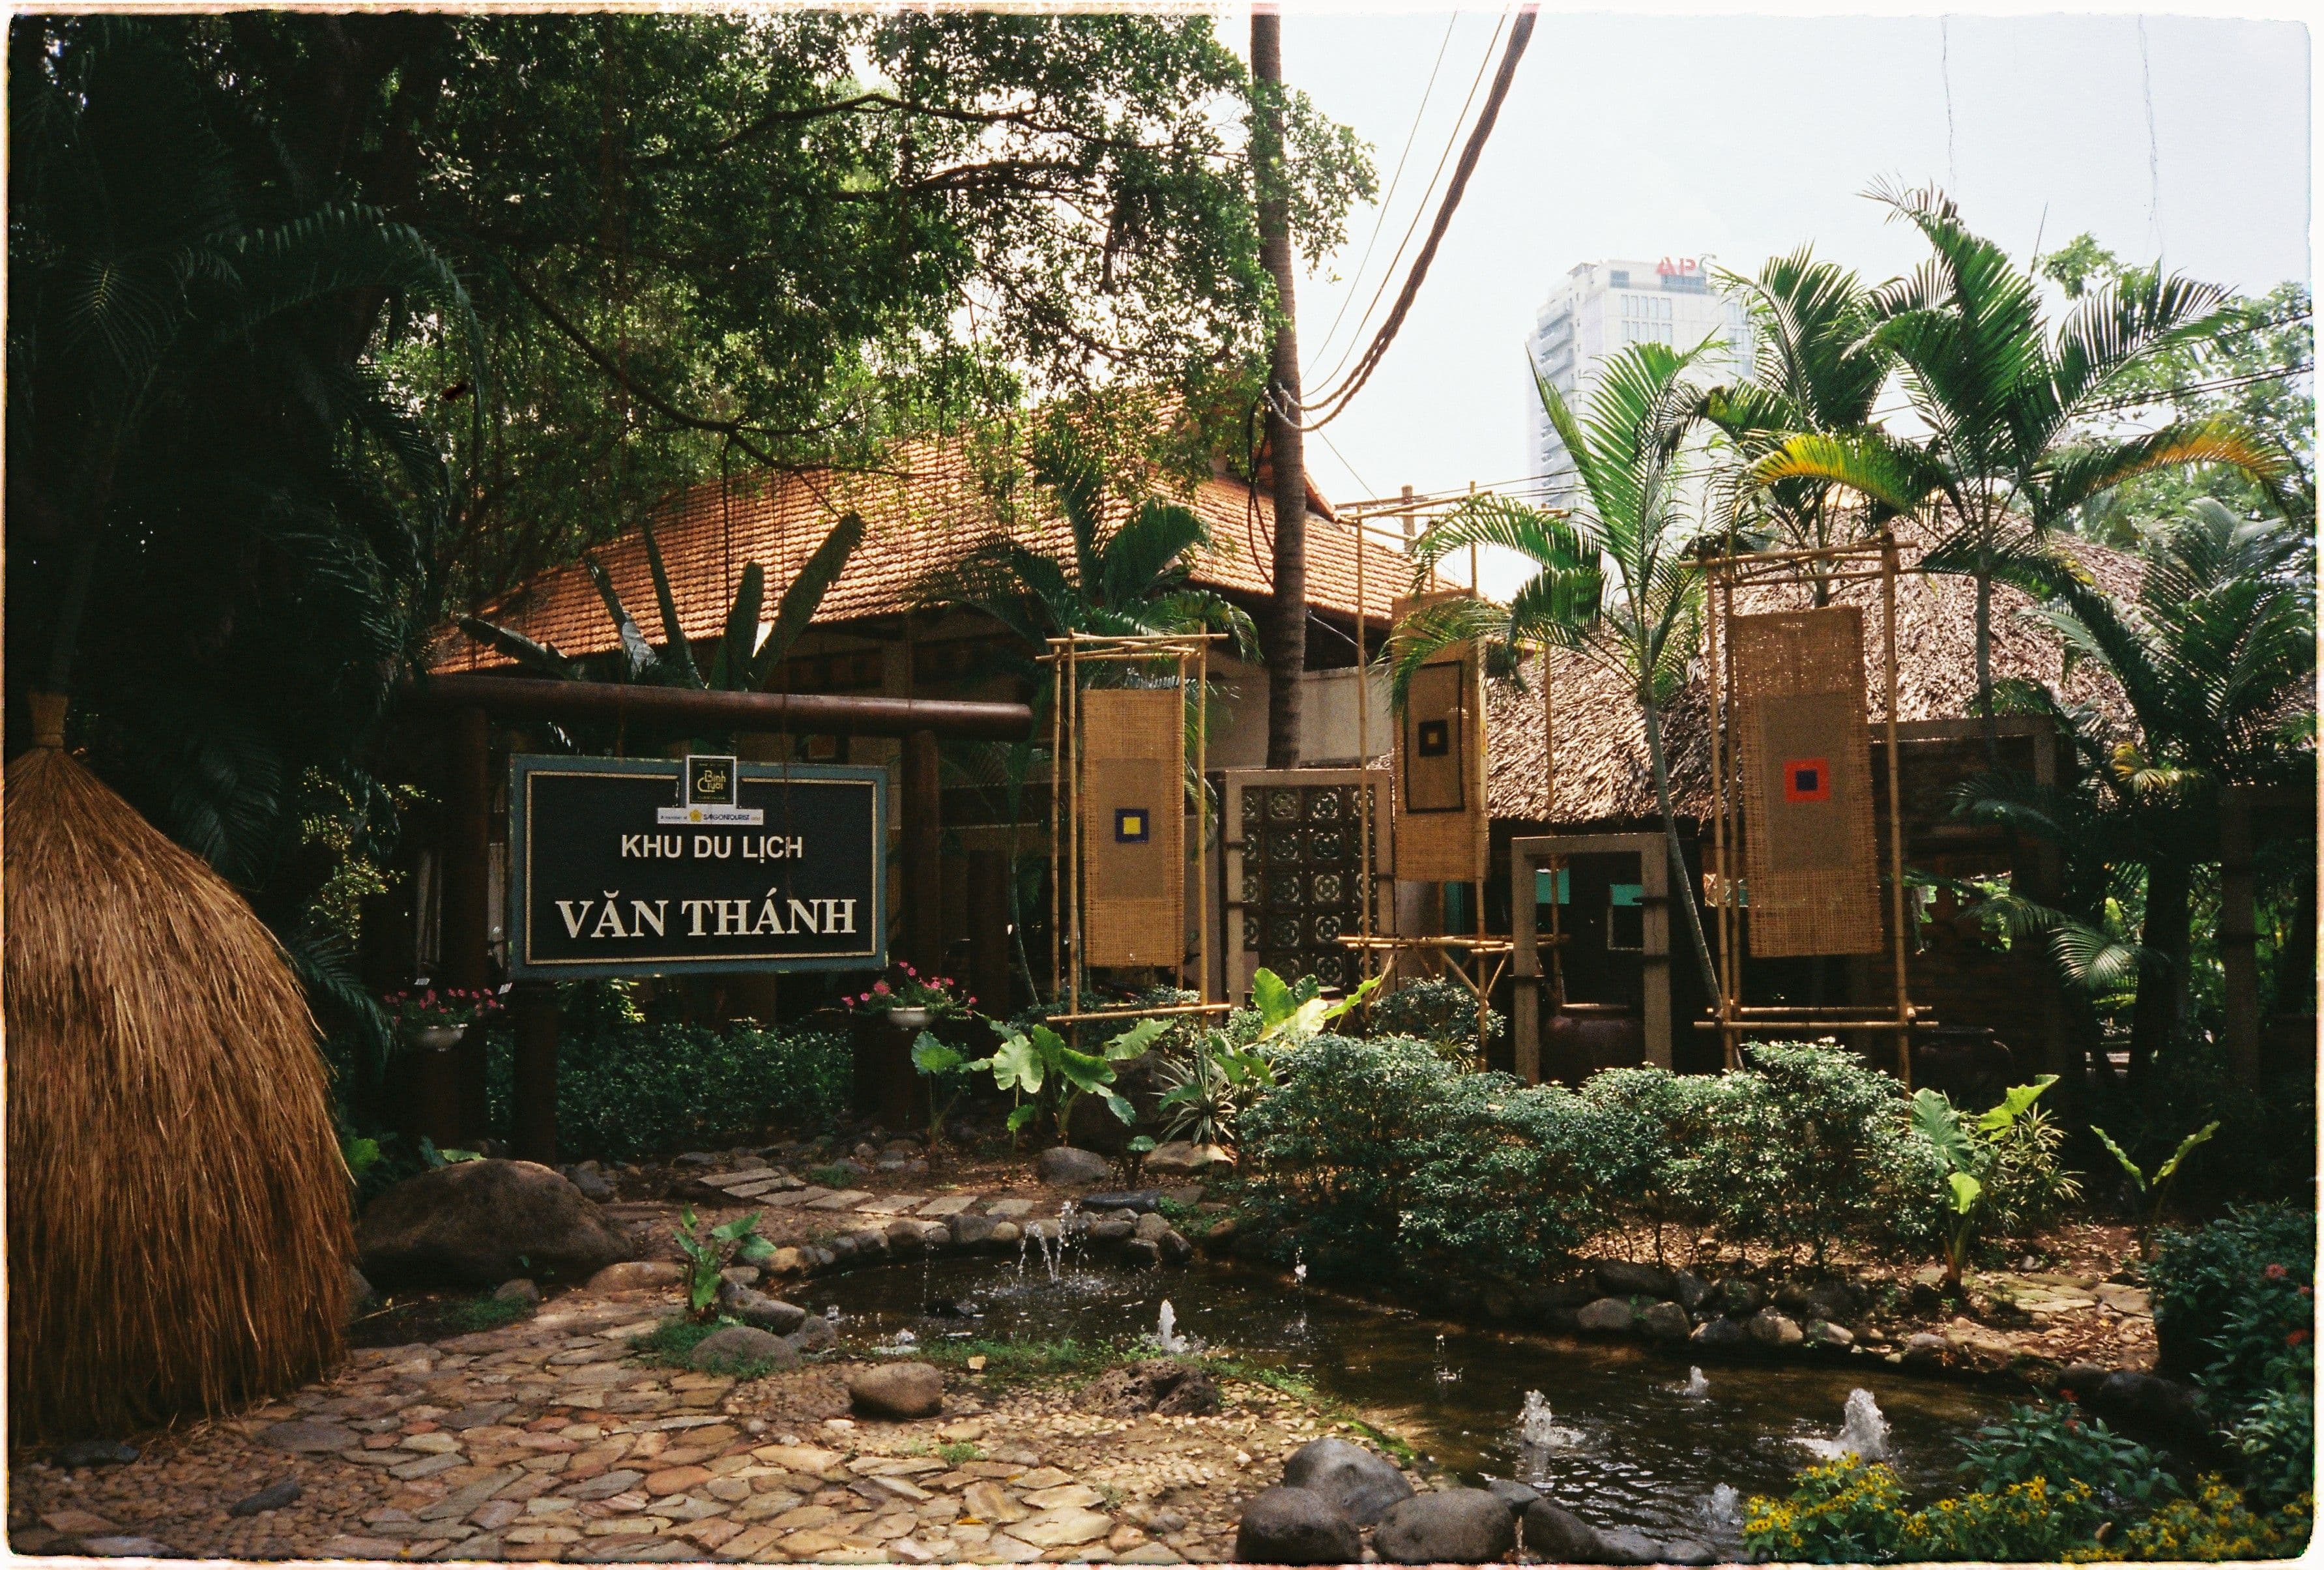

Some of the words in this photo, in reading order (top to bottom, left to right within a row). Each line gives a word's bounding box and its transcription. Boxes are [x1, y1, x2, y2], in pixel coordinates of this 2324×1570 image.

[622, 834, 682, 858] KHU
[694, 836, 731, 858] DU
[743, 836, 802, 864] LỊCH
[555, 890, 669, 938] VĂN
[681, 887, 857, 936] THÁNH
